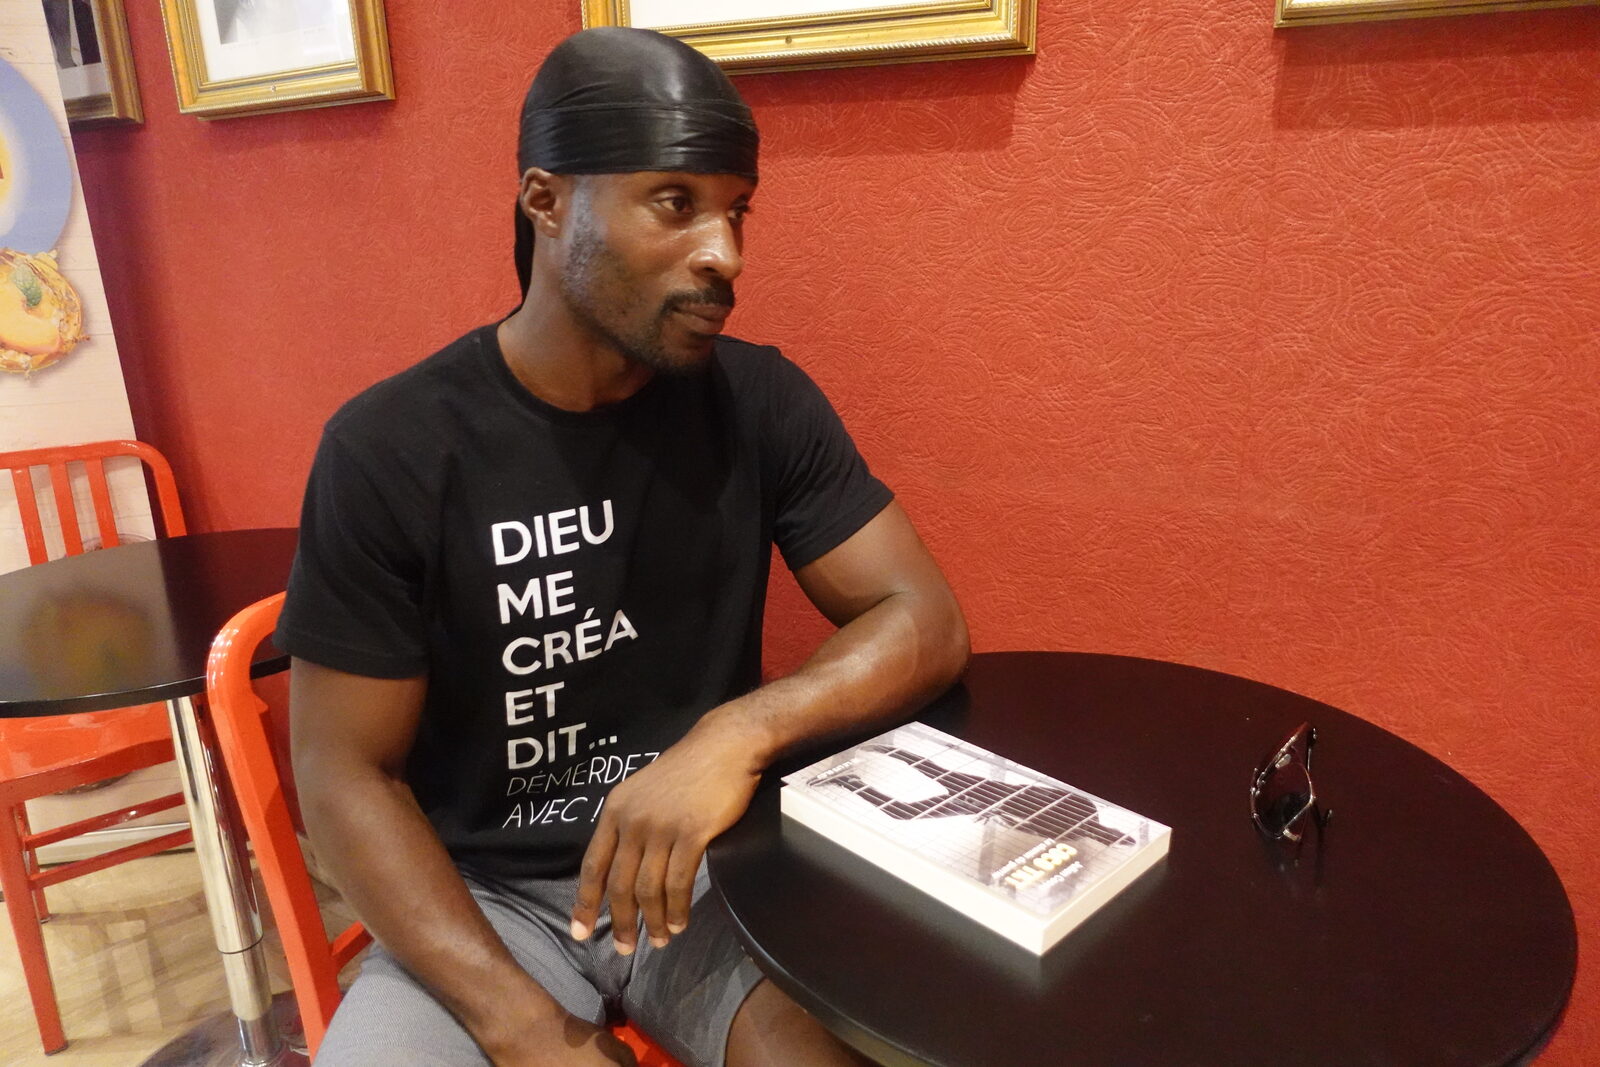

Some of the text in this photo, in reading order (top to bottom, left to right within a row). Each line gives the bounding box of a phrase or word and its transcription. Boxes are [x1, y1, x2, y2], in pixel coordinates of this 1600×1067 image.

[491, 500, 614, 565] DIEU
[497, 570, 576, 624] ME
[502, 607, 639, 676] CRÉA
[505, 681, 565, 726] ET
[502, 796, 588, 828] AVEC
